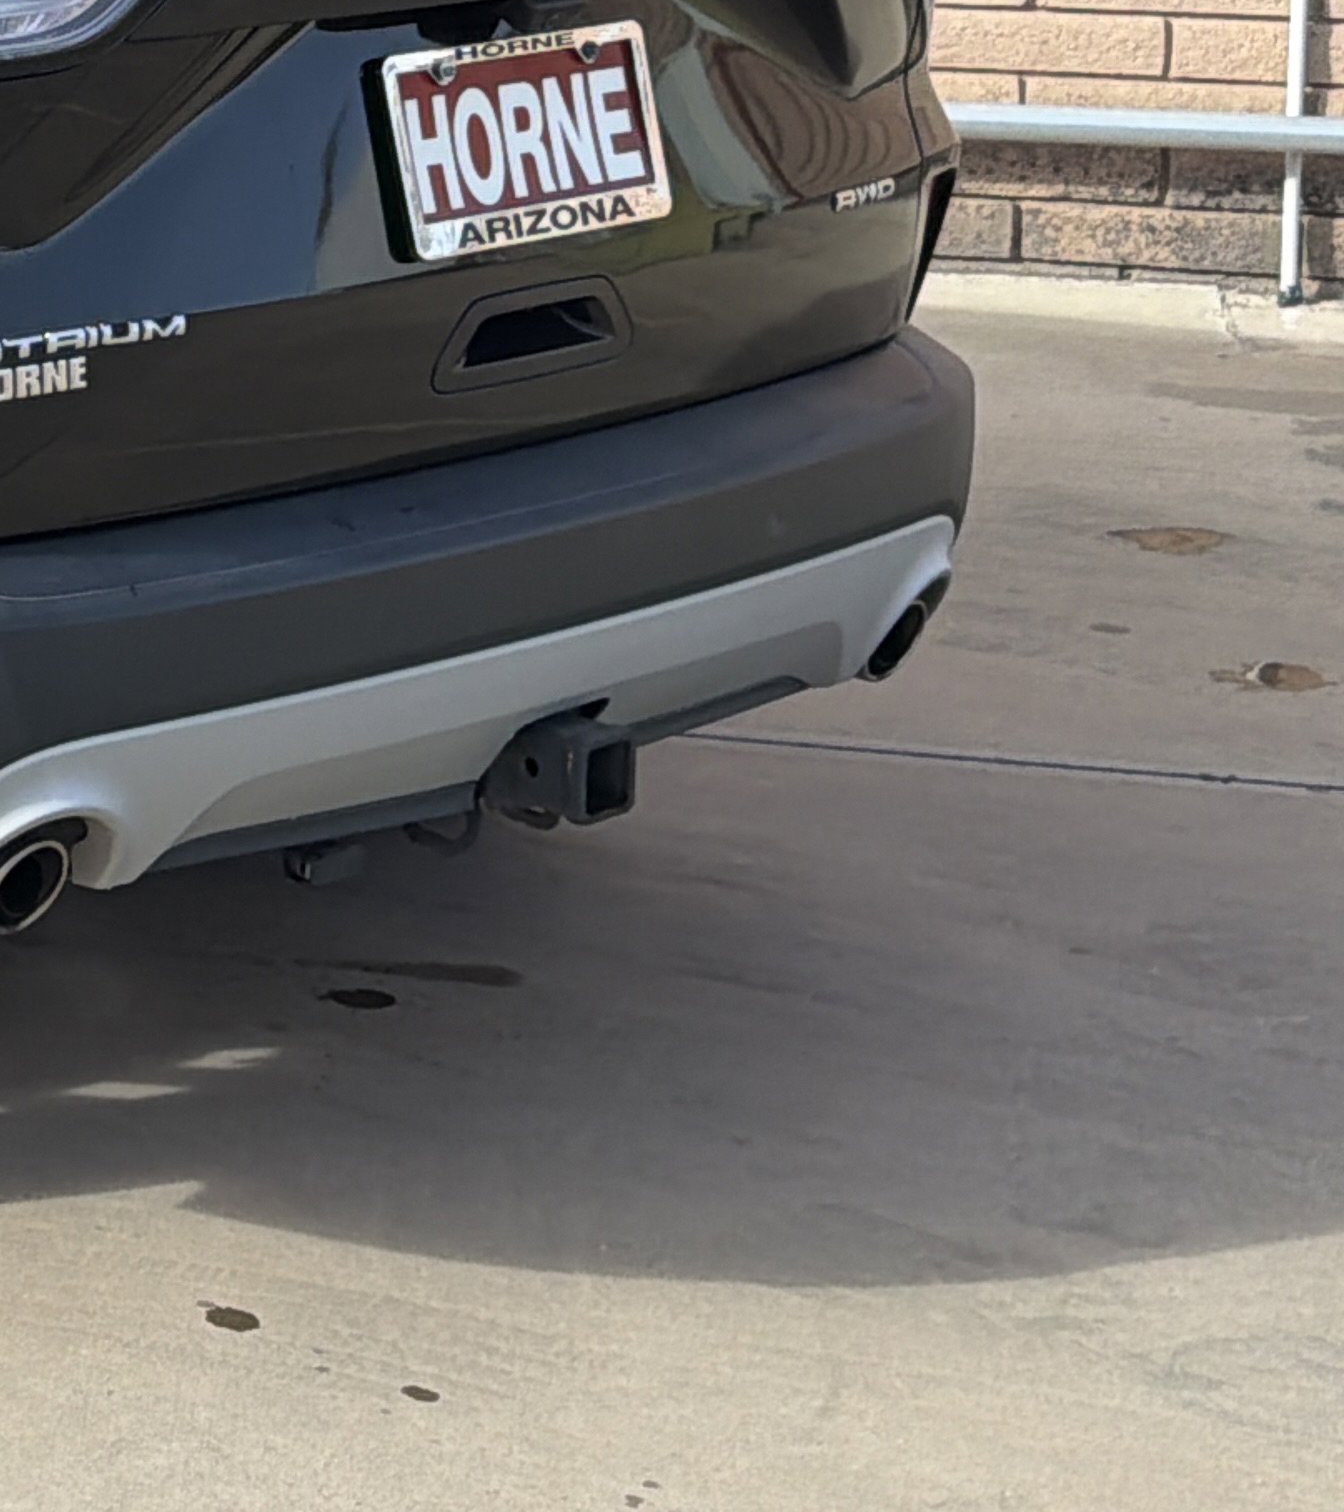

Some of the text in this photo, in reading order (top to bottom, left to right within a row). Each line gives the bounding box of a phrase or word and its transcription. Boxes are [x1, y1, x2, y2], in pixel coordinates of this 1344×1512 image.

[455, 32, 576, 61] HORNE
[404, 67, 646, 214] HORNE
[835, 178, 896, 211] AWD
[457, 195, 635, 249] ARIZONA
